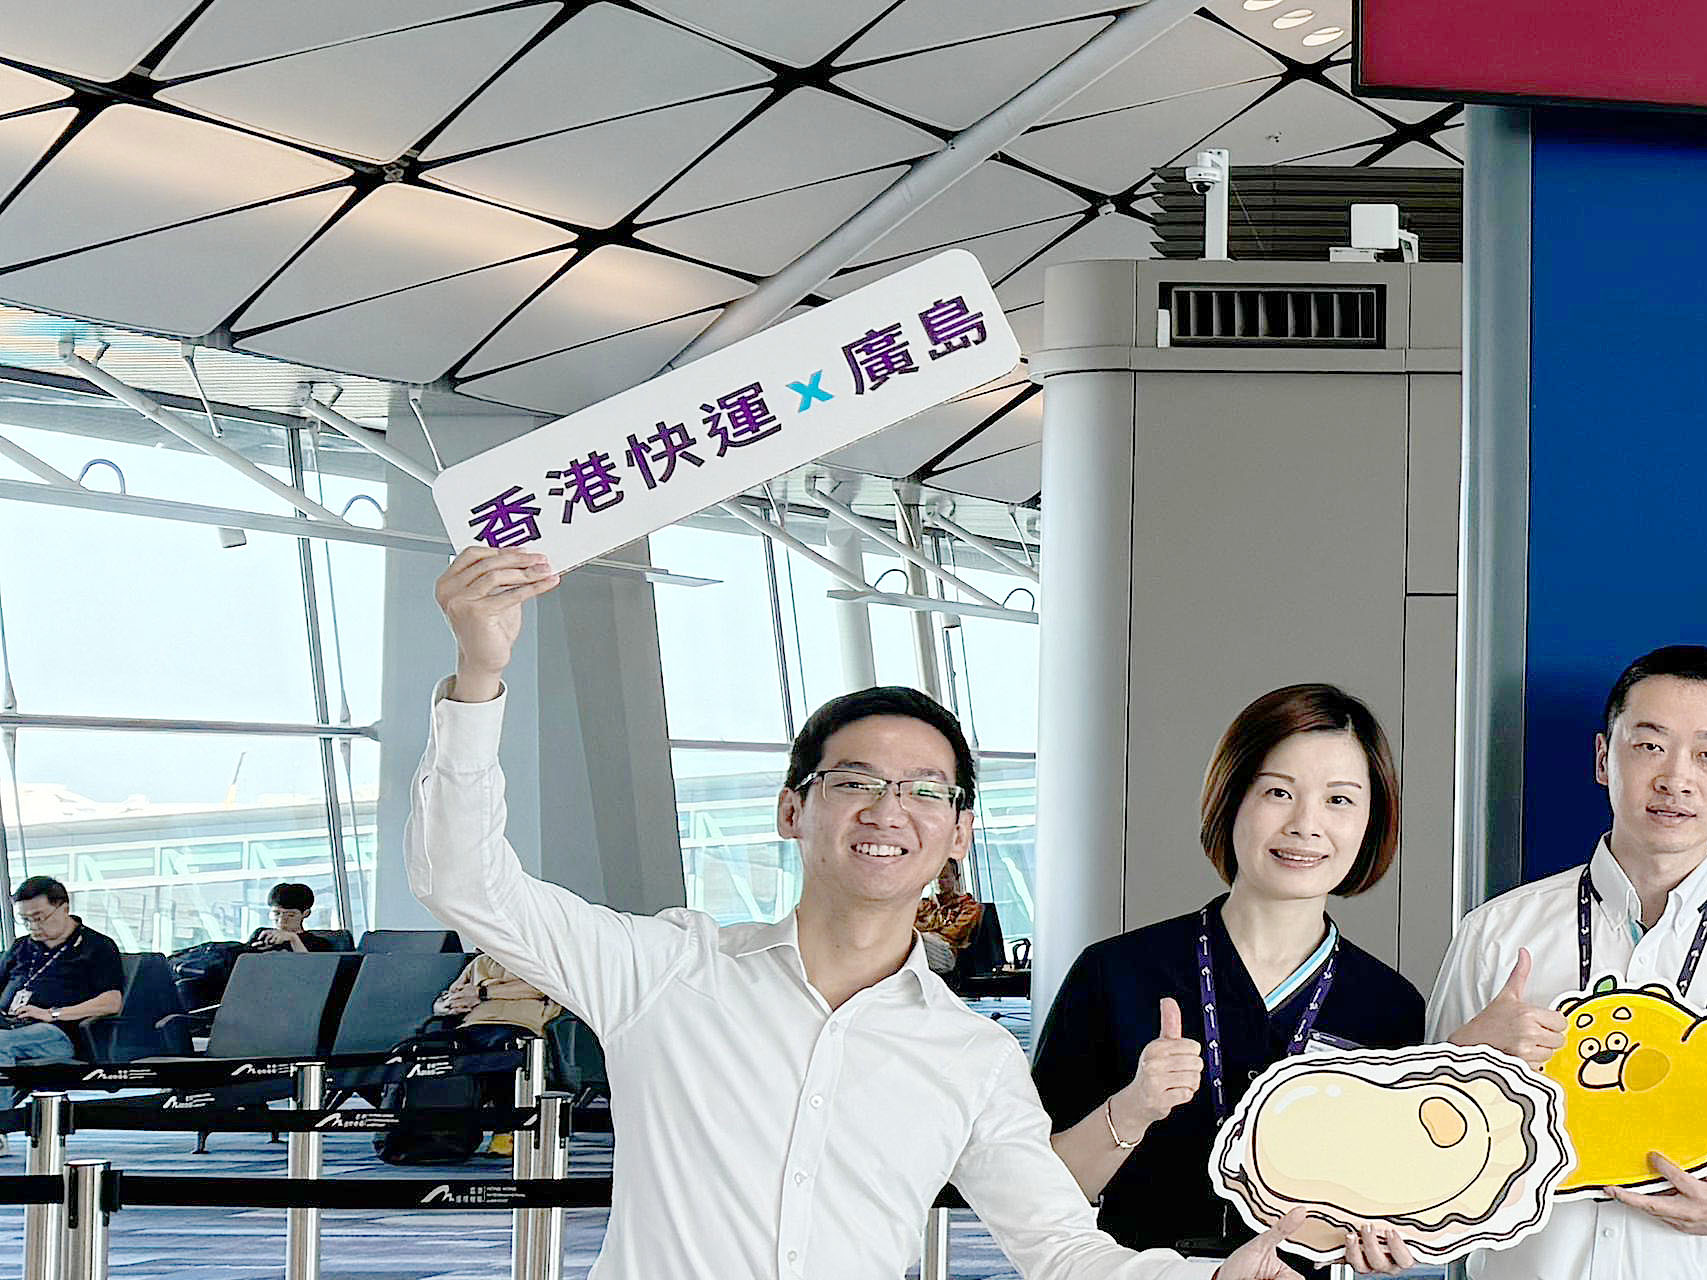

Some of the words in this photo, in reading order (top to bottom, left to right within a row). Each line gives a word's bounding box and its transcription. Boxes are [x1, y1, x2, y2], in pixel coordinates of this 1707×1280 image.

[468, 381, 782, 548] 香港快運
[840, 295, 988, 396] 廣島
